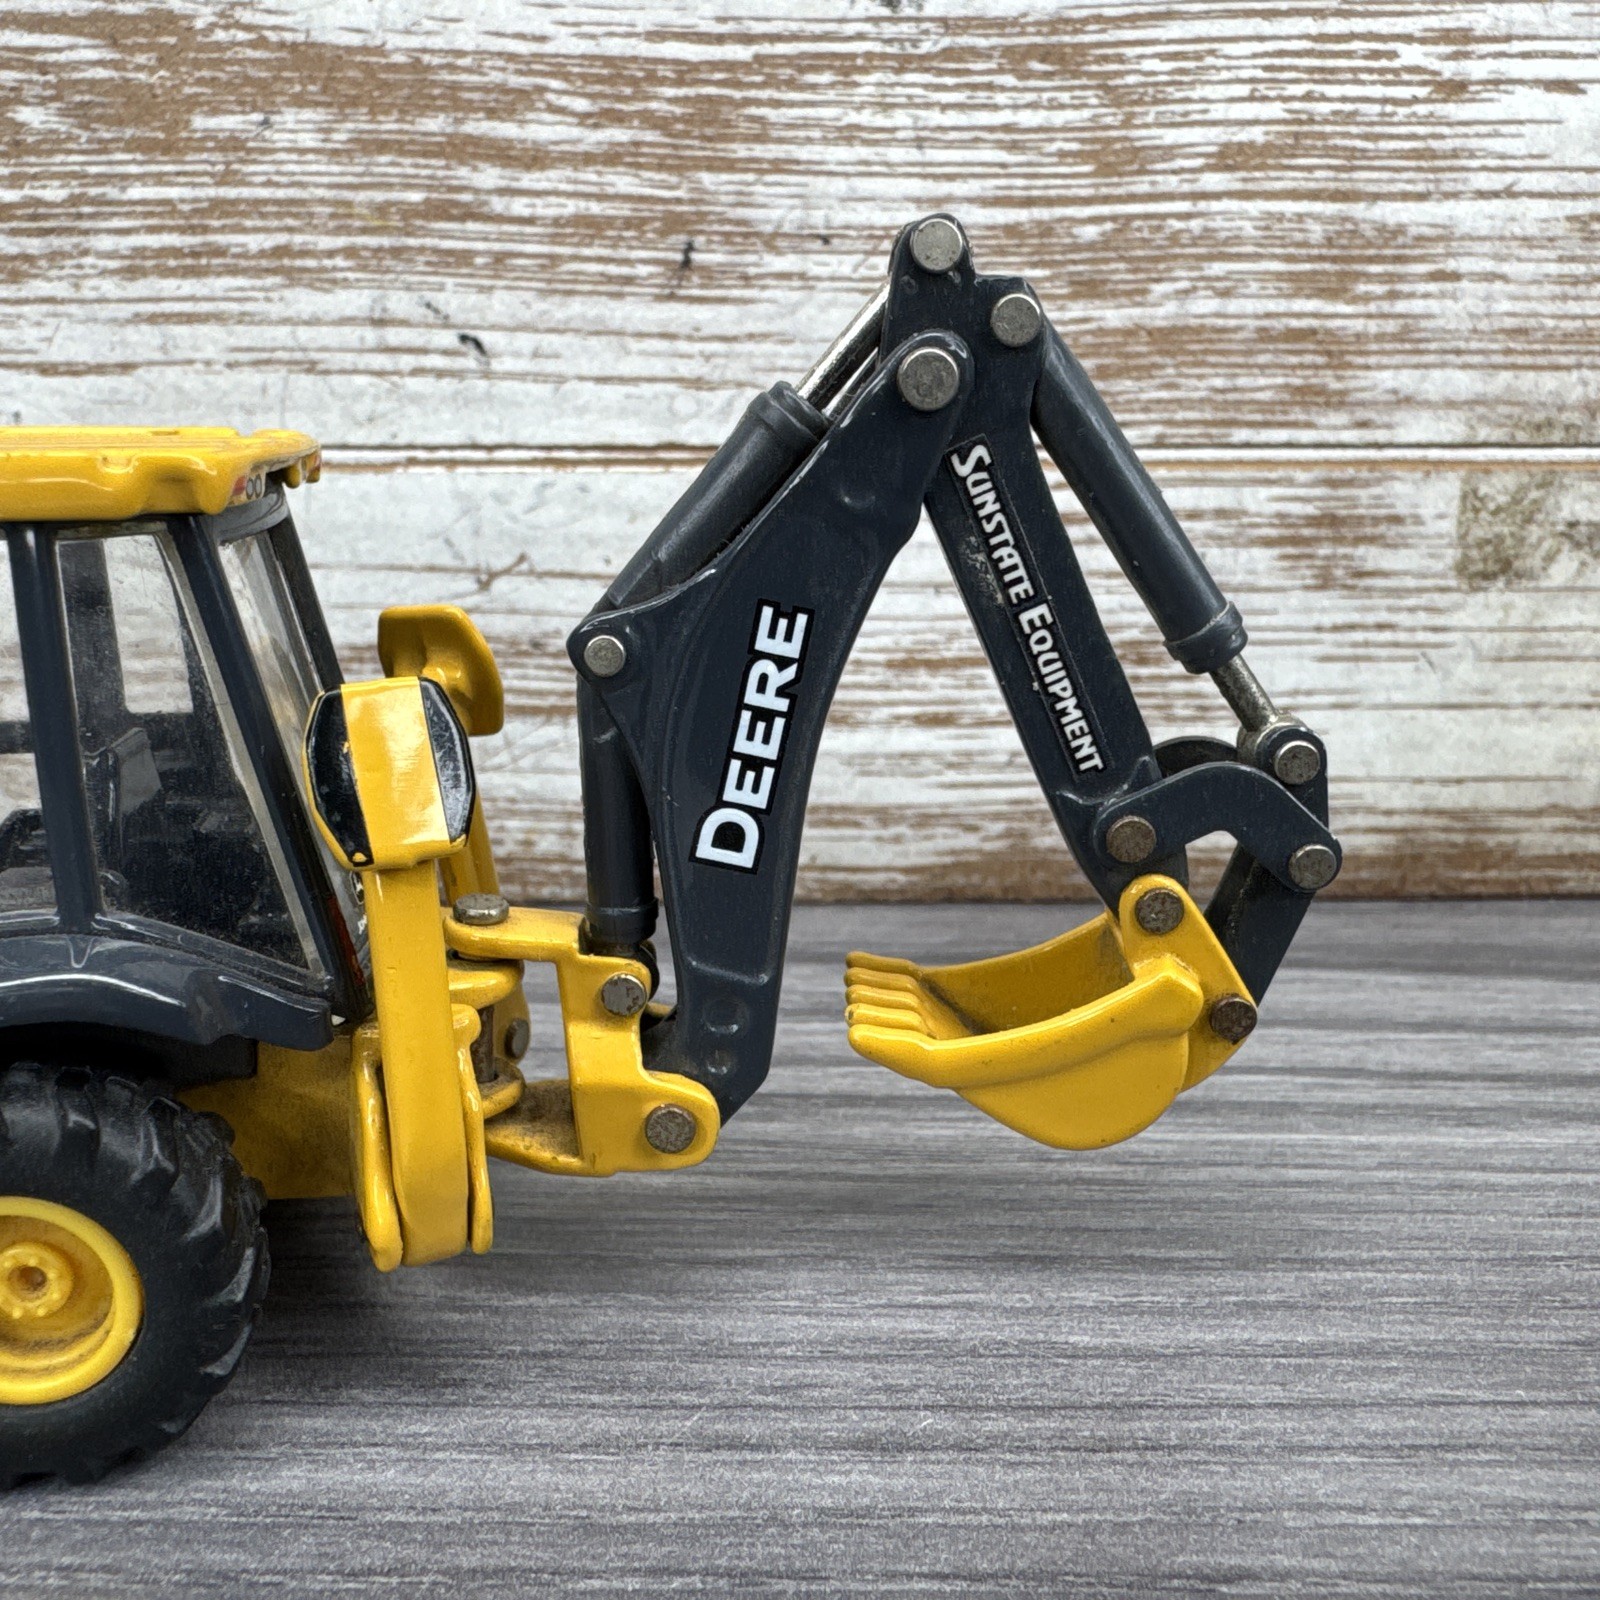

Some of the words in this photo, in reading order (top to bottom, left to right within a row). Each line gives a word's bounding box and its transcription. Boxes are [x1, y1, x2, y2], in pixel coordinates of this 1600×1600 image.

[695, 605, 808, 869] DEERE
[951, 444, 1035, 605] SUNSTATE
[1018, 603, 1104, 772] EQUIPMENT
